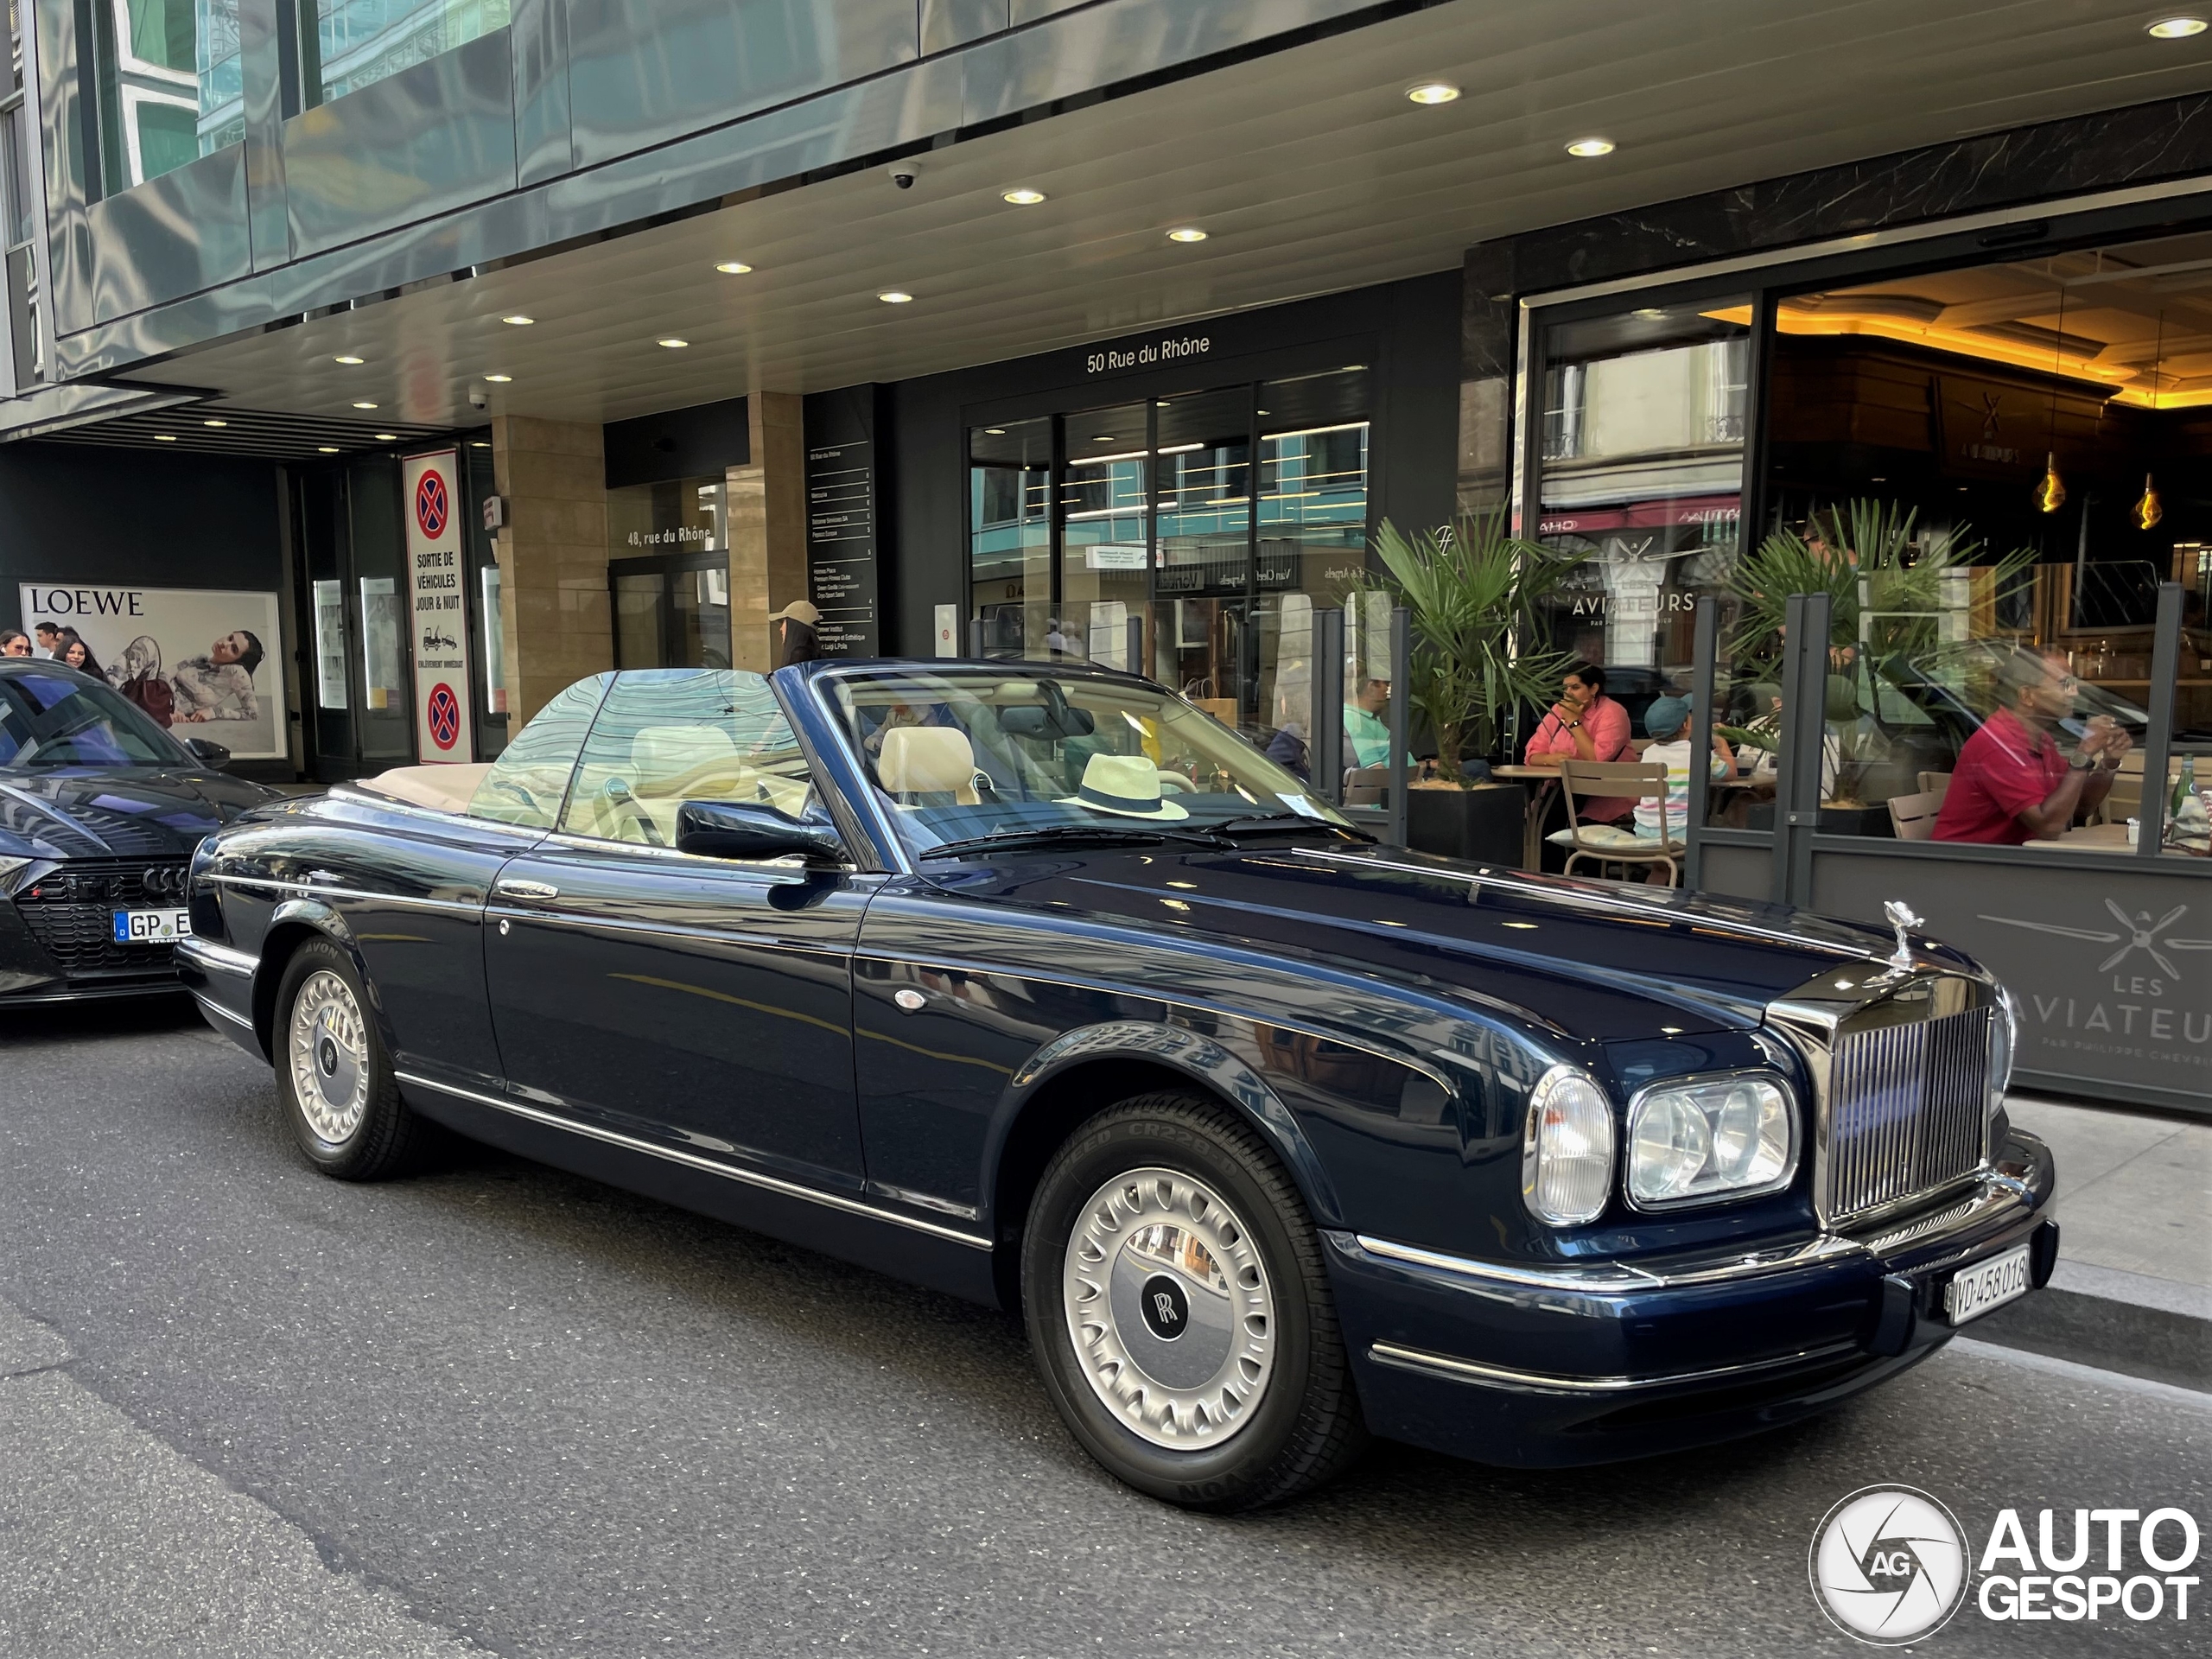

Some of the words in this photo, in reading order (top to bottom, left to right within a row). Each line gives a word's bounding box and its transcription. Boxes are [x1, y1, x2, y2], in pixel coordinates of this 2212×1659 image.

[1087, 353, 1104, 373] 50
[1109, 351, 1135, 369] Rue
[1139, 345, 1157, 364] du
[1162, 336, 1210, 359] Rhône
[627, 531, 642, 548] 48,
[644, 533, 660, 544] rue
[663, 529, 676, 543] du
[678, 525, 711, 542] Rhône
[417, 552, 442, 568] SORTIE
[444, 551, 454, 566] DE
[416, 572, 456, 589] VÉHICULES
[31, 588, 144, 616] LOEWE
[416, 597, 435, 611] JOUR
[435, 596, 442, 610] &
[443, 595, 460, 610] NUIT
[1573, 593, 1694, 615] AVIATEURS
[130, 915, 161, 937] GP
[305, 942, 338, 960] AVON
[2113, 975, 2164, 996] LES
